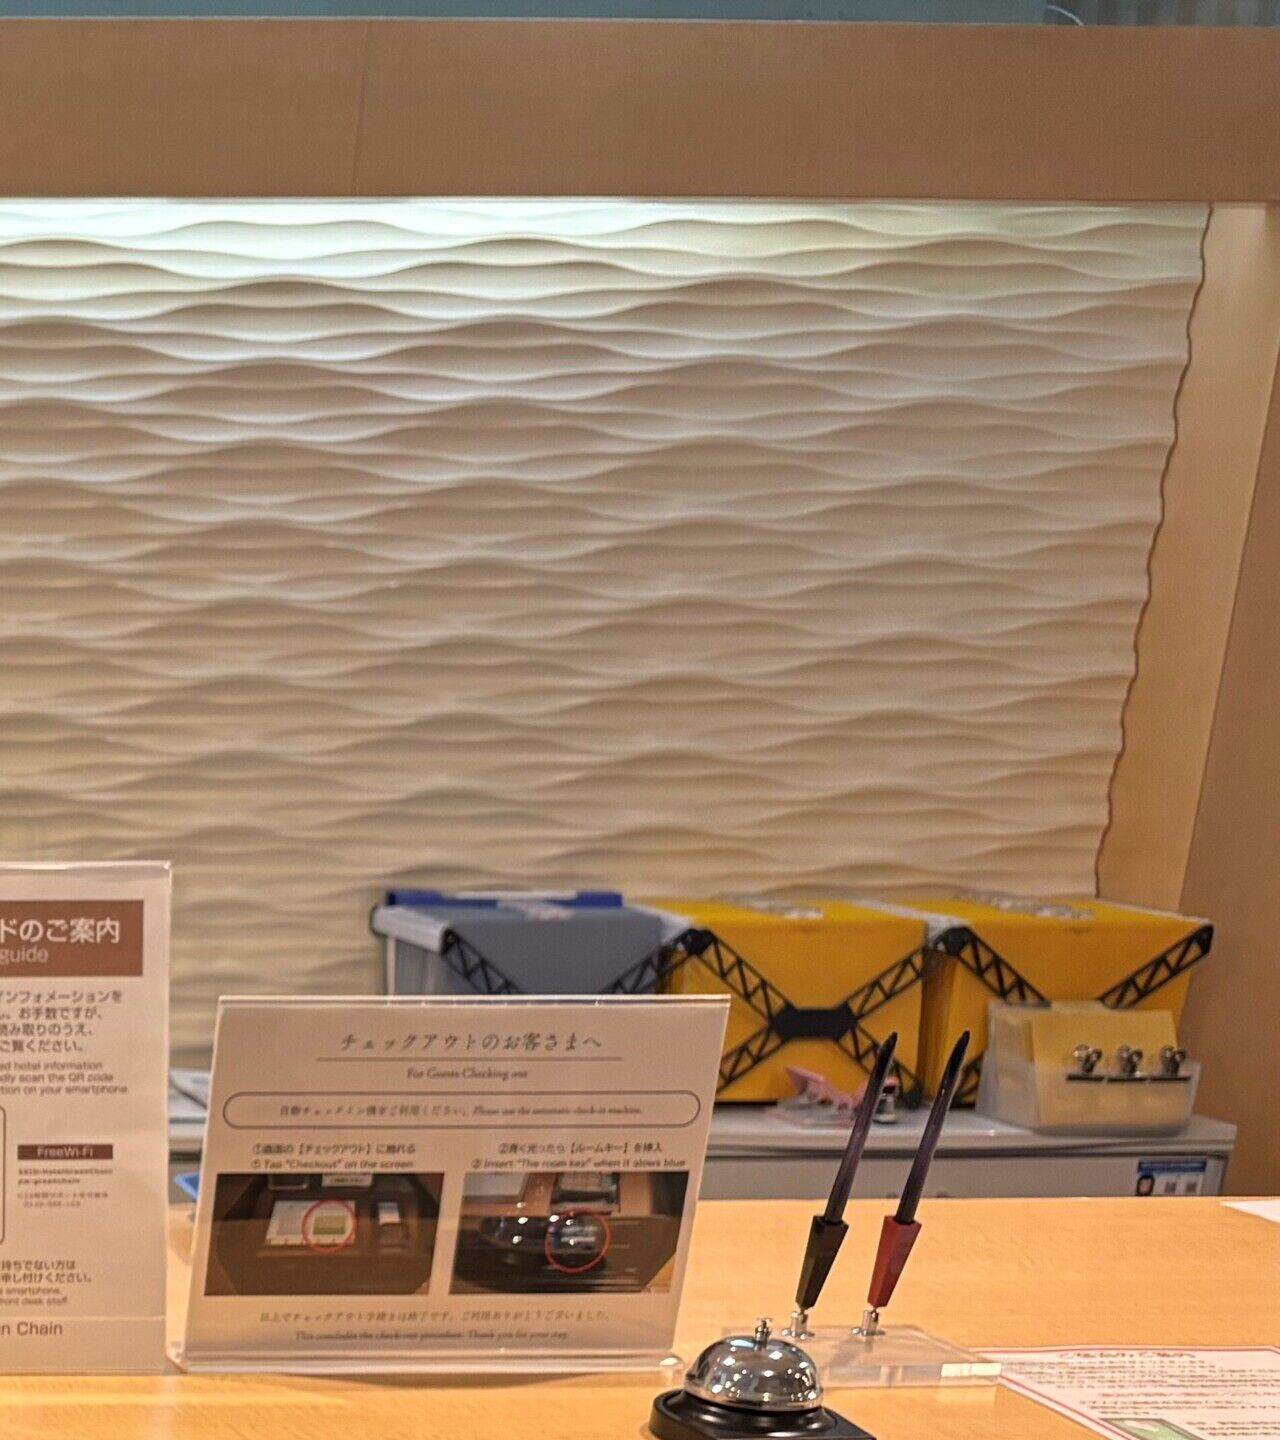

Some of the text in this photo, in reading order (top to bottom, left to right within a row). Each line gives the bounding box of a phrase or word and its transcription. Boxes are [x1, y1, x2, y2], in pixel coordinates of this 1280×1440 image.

[341, 1032, 602, 1050] チェックアウトのお客さまへ
[14, 1061, 41, 1073] hotel
[43, 1061, 102, 1073] information
[407, 1067, 424, 1078] For
[462, 1067, 508, 1081] Checking
[17, 1322, 63, 1336] Chain
